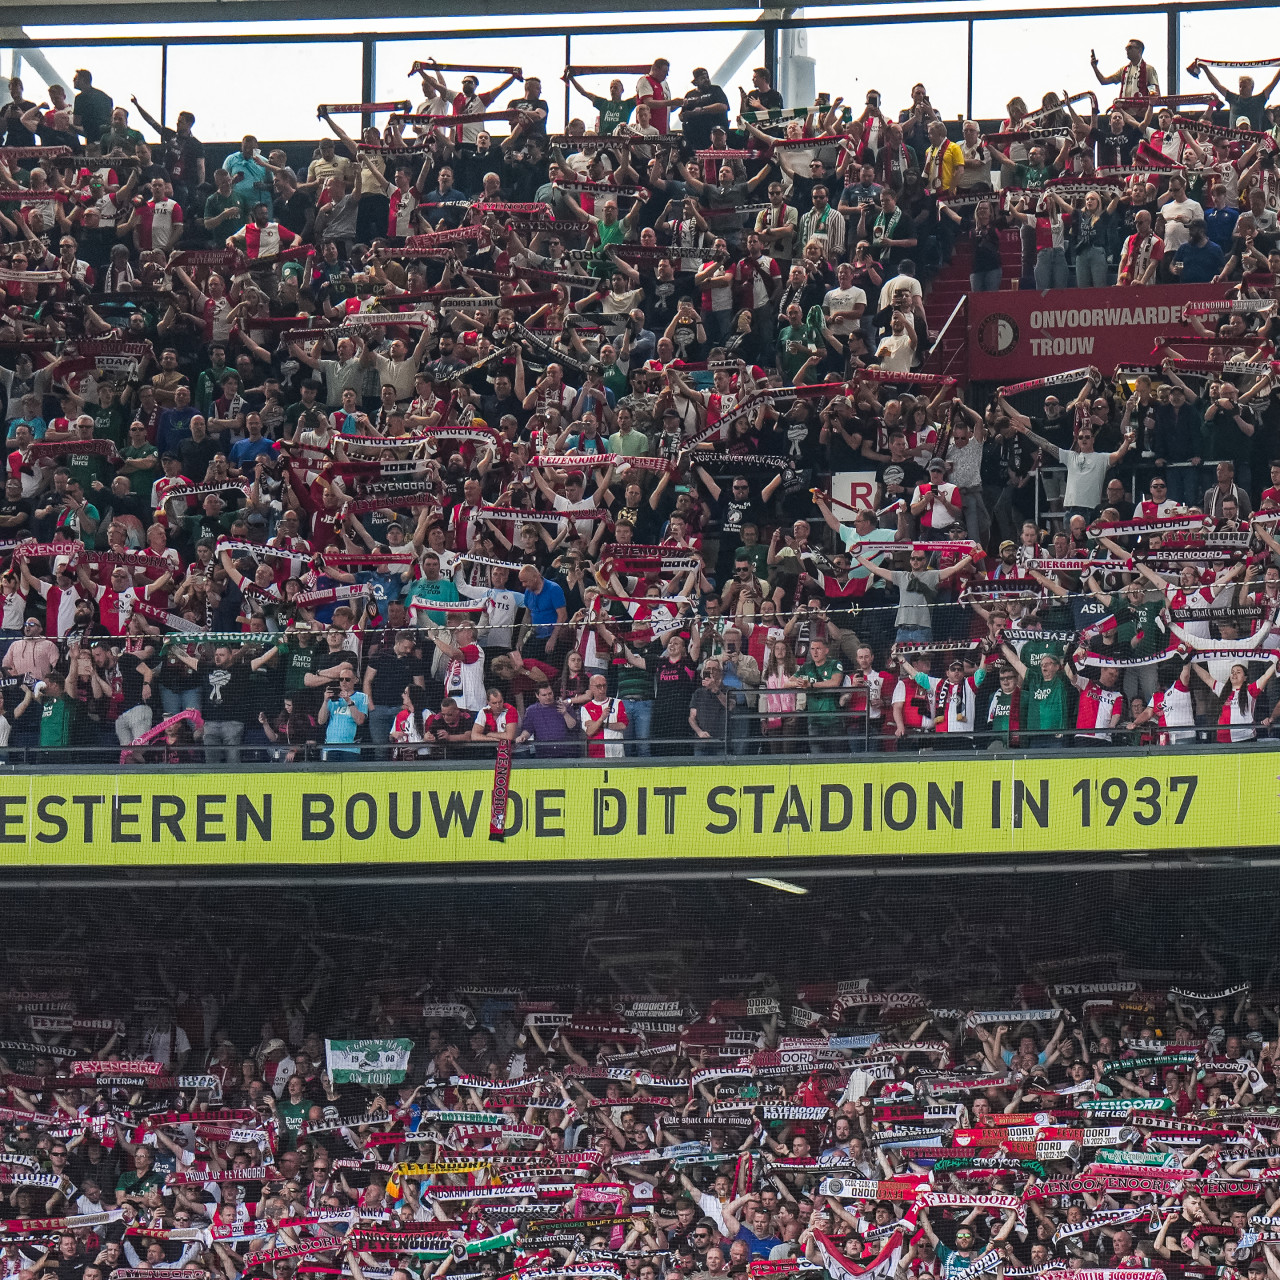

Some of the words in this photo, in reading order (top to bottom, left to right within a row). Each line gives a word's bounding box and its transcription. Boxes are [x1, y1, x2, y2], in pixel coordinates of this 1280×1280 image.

[1030, 337, 1094, 356] TROUW
[850, 483, 874, 507] R
[0, 793, 273, 844] ESTEREN
[593, 785, 688, 836] DIT
[704, 779, 964, 834] STADION
[989, 778, 1051, 829] IN
[1072, 774, 1199, 827] 1937
[73, 1061, 163, 1073] FEYENOORD
[441, 1112, 500, 1123] ROTTERDAM
[763, 1107, 829, 1116] FEYENOORD
[763, 1113, 828, 1121] ROTTERDAM
[185, 1171, 206, 1183] PROUD
[208, 1171, 219, 1181] OF
[223, 1166, 267, 1180] FEYENOORD
